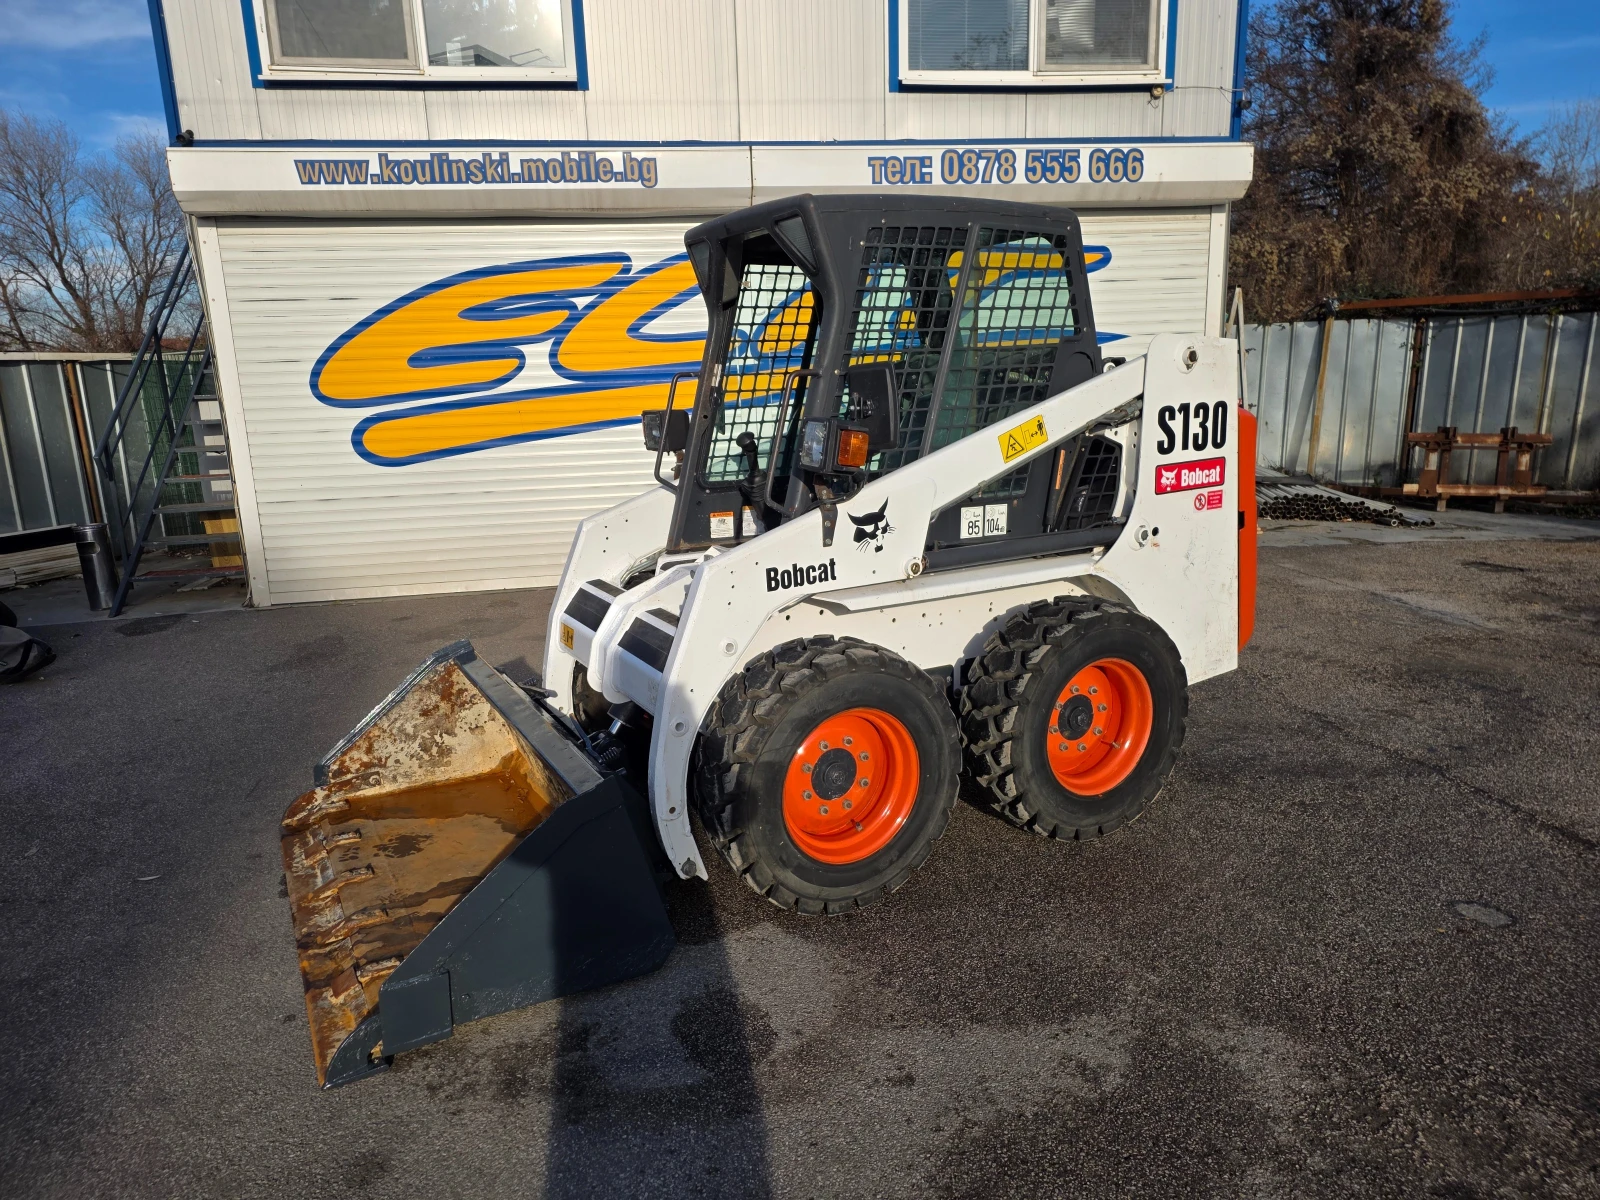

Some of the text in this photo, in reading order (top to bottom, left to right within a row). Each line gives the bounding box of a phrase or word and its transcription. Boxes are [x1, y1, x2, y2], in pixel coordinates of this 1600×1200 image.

[294, 151, 658, 188] www.koulinski.mobile.bg
[868, 147, 1144, 184] тел: 0878 555 666
[1156, 400, 1228, 455] S130
[1180, 465, 1221, 487] Bobcat
[967, 519, 980, 536] 85
[986, 517, 1000, 534] 104
[765, 557, 837, 592] Bobcat
